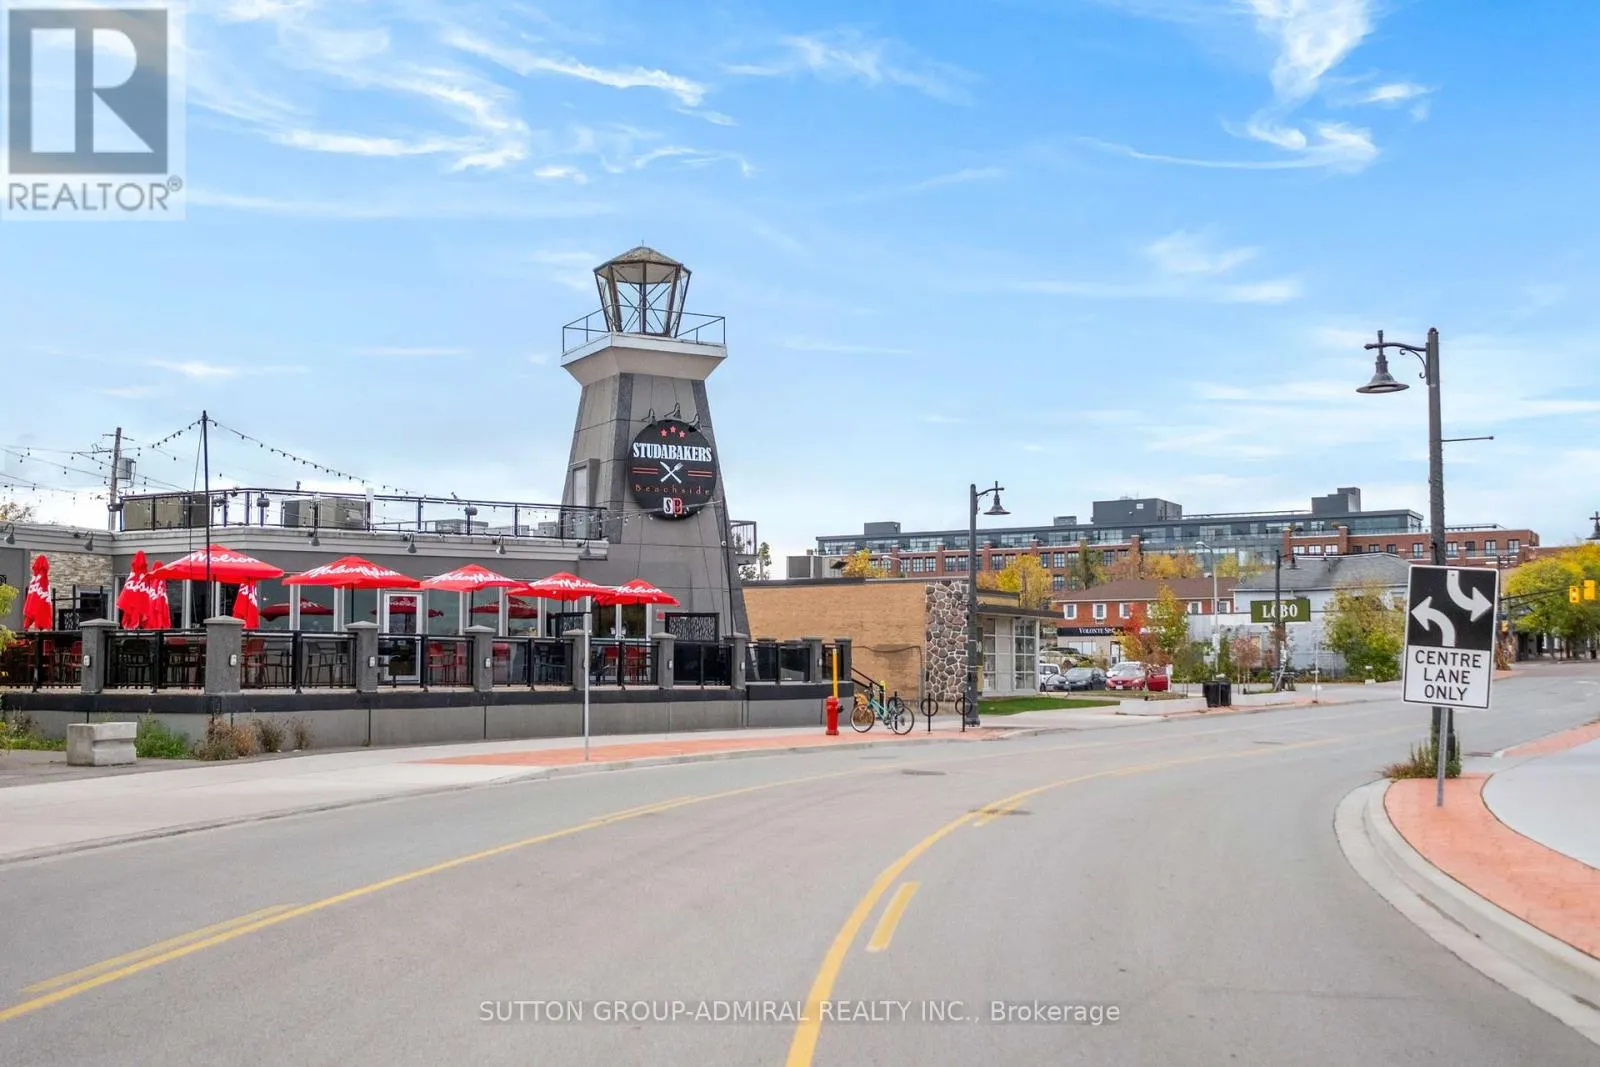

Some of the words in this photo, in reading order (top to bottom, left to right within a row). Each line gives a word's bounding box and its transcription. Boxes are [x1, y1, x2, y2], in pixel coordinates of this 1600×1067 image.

[633, 442, 712, 462] STUDABAKERS
[1415, 650, 1482, 669] CENTRE
[1424, 667, 1471, 685] LANE
[1424, 684, 1468, 701] ONLY
